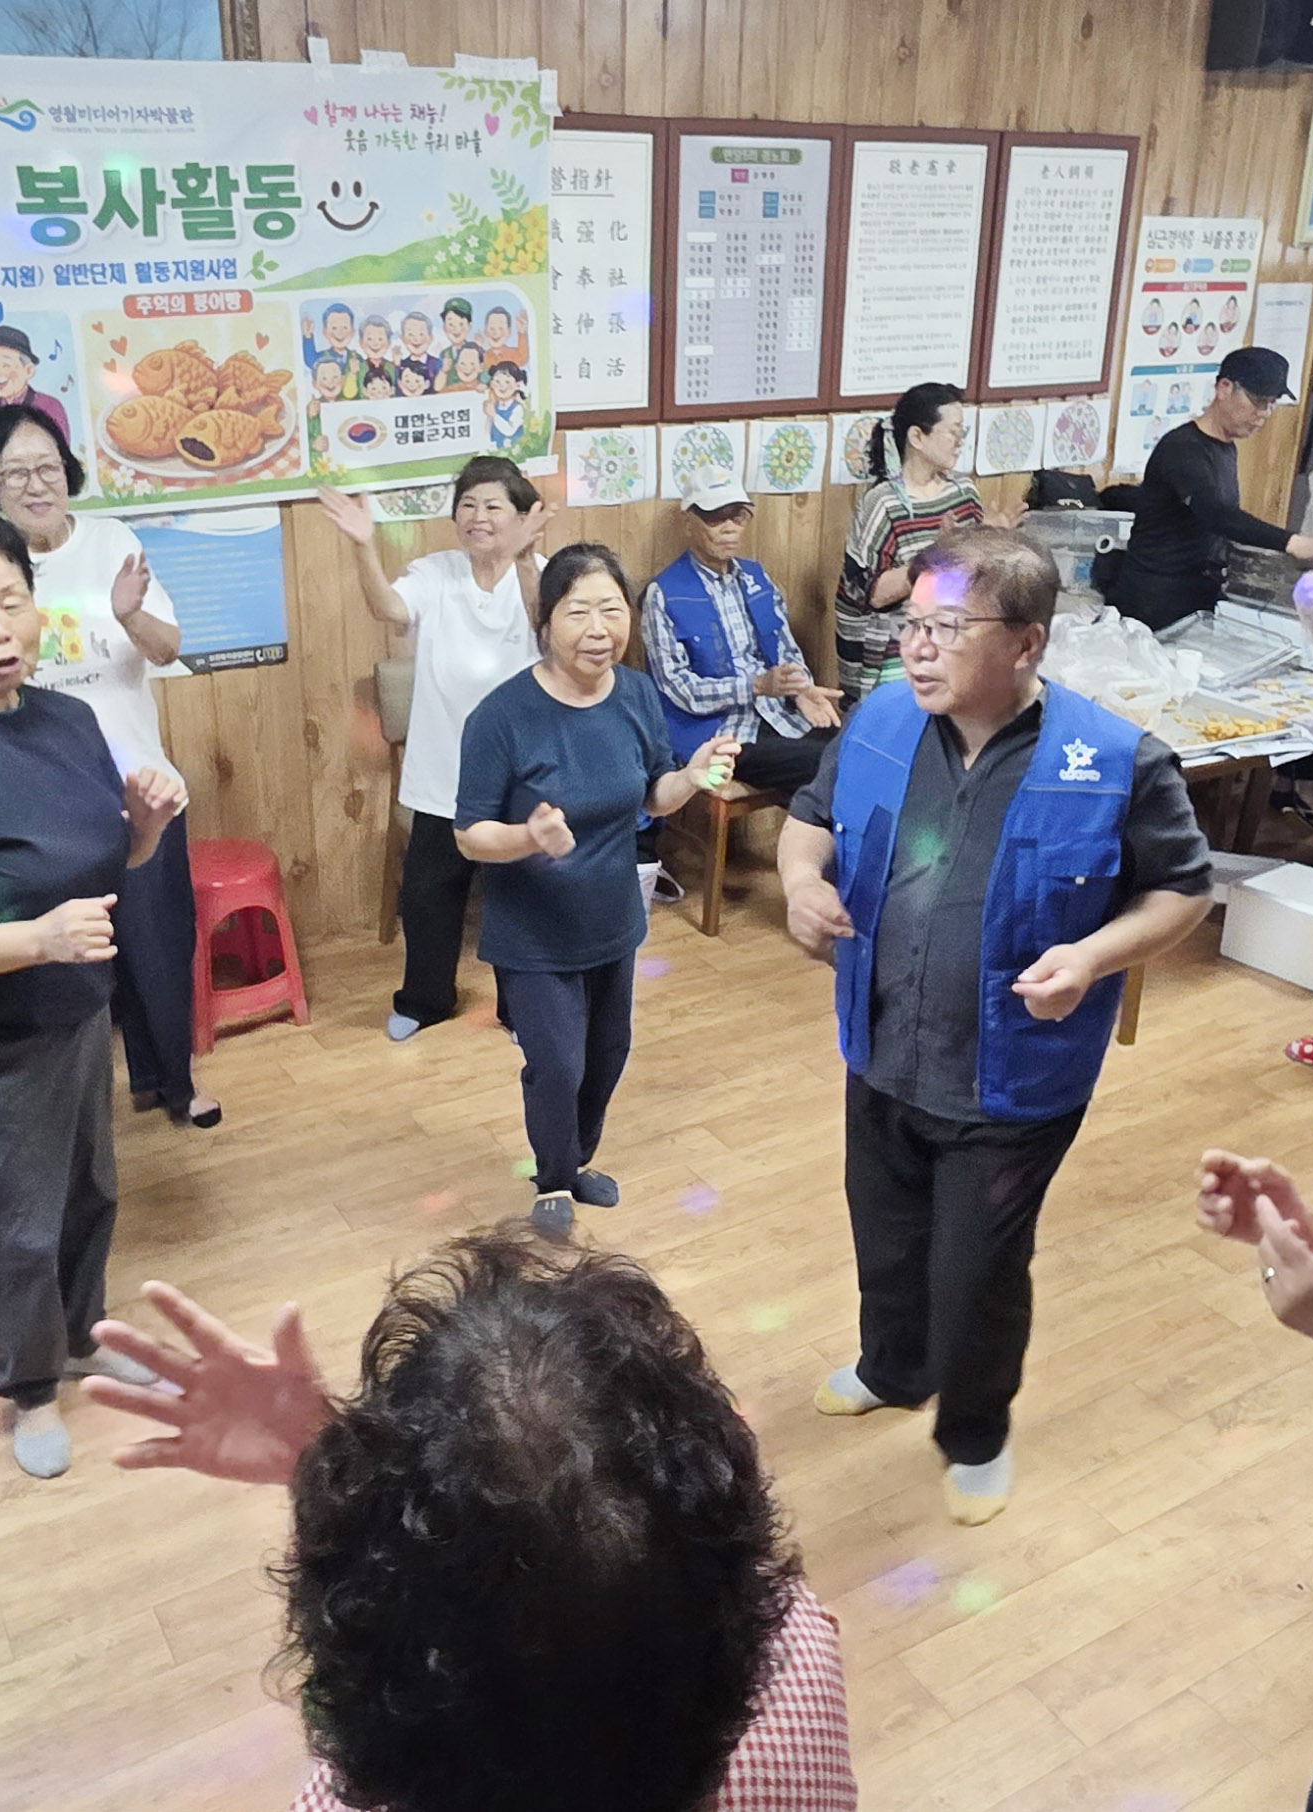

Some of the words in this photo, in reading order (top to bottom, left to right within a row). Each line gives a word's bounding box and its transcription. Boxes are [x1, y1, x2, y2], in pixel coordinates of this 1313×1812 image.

[48, 104, 194, 125] 영월미디어기자박물관
[324, 99, 358, 127] 함께
[364, 103, 403, 123] 나누는
[344, 128, 369, 155] 웃음
[375, 129, 418, 151] 가득한
[425, 126, 449, 153] 우리
[455, 129, 482, 156] 마을
[15, 161, 304, 248] 봉사활동
[53, 262, 127, 288] 일반단체
[134, 257, 238, 284] 활동지원사업
[135, 293, 187, 316] 추억의
[394, 424, 471, 446] 영월군지회
